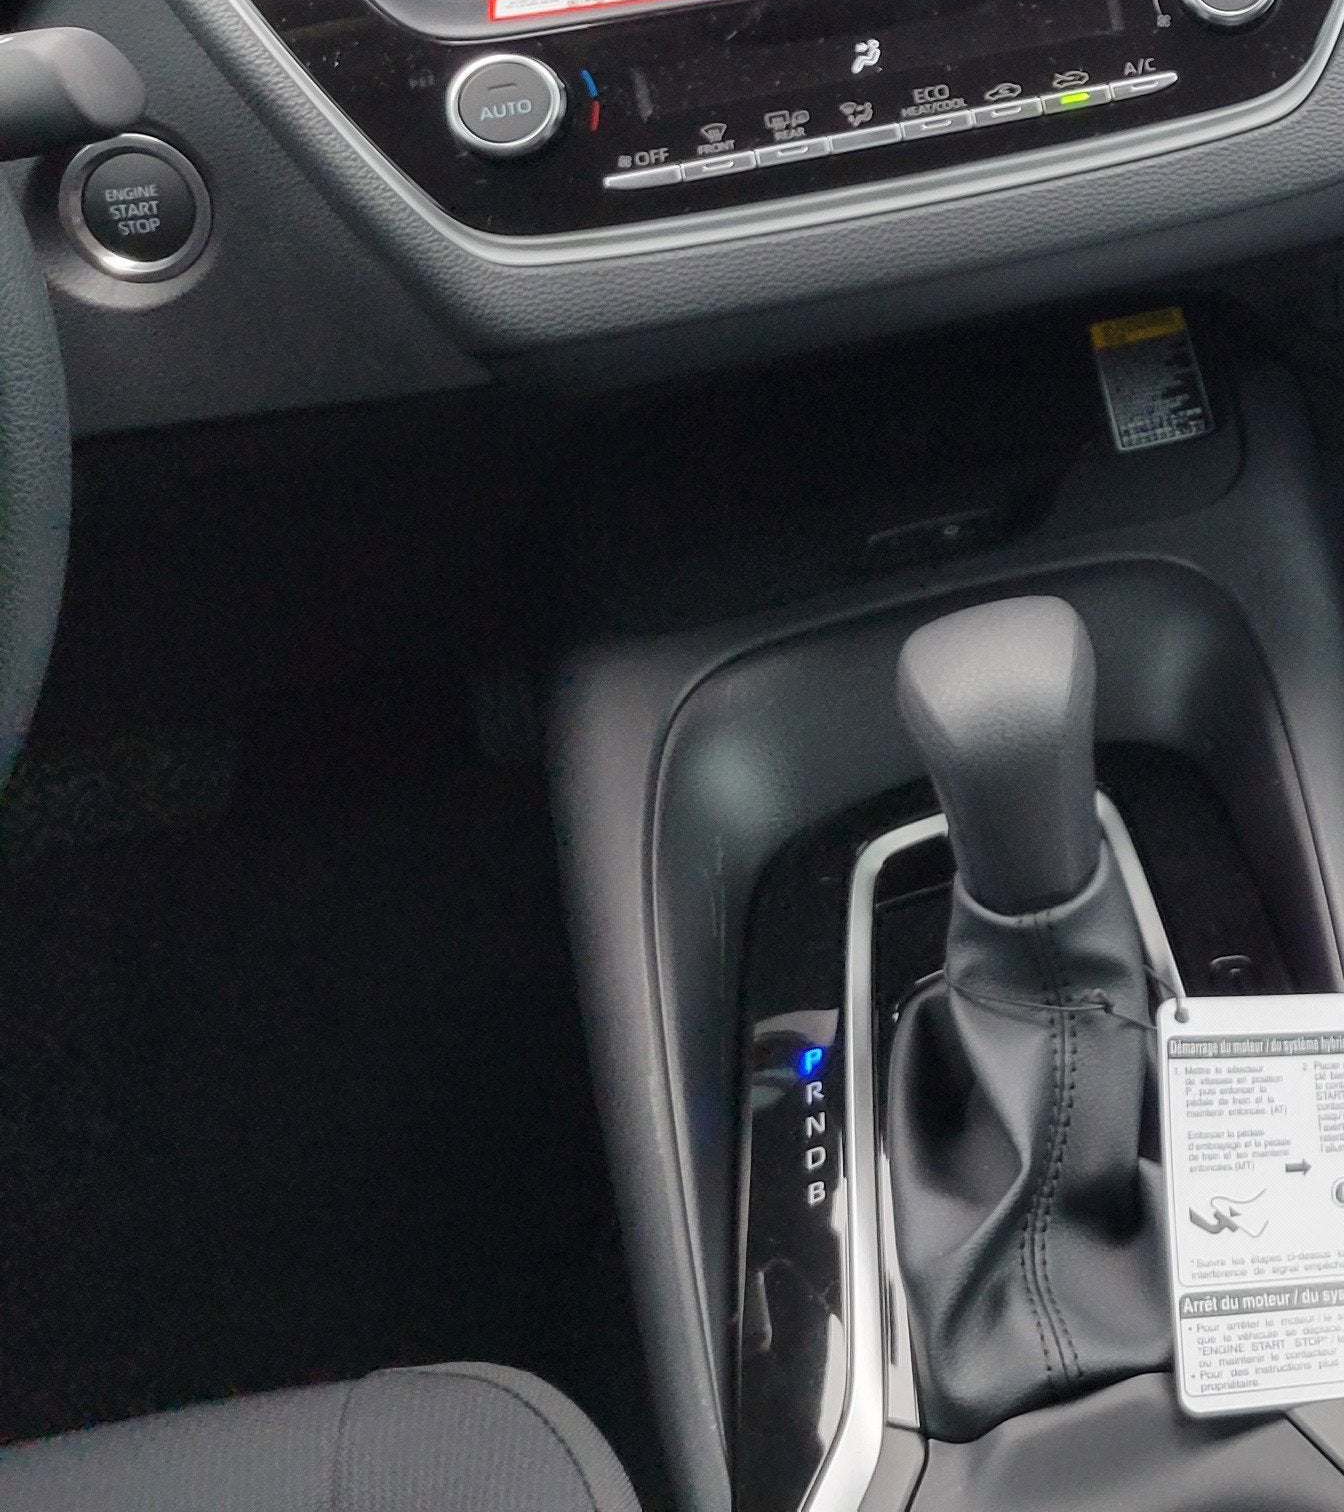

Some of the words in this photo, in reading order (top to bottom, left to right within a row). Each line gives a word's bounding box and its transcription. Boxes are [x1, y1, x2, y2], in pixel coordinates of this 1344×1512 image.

[1124, 57, 1157, 76] A/C
[914, 84, 949, 104] ECO
[481, 99, 532, 121] AUTO
[901, 97, 967, 118] HEAT/COOL
[774, 126, 808, 141] REAR
[697, 139, 736, 155] FRONT
[635, 147, 670, 167] OFF
[105, 184, 157, 202] ENGINE
[109, 200, 160, 219] START
[117, 218, 161, 236] STOP
[1171, 1040, 1218, 1056] Démarrage
[1220, 1040, 1231, 1052] du
[1233, 1039, 1264, 1052] moteur
[1271, 1038, 1281, 1051] du
[1284, 1037, 1319, 1053] système
[804, 1048, 824, 1072] P
[805, 1081, 824, 1103] R
[805, 1112, 826, 1137] N
[805, 1146, 827, 1171] D
[807, 1182, 826, 1207] B
[1184, 1296, 1218, 1312] Arrêt
[1221, 1295, 1238, 1310] du
[1243, 1293, 1290, 1309] moteur
[1301, 1288, 1318, 1304] du
[1197, 1324, 1219, 1332] Pour
[1227, 1319, 1260, 1329] arrêter
[1197, 1334, 1216, 1345] que
[1252, 1339, 1285, 1351] START
[1219, 1355, 1265, 1366] maintenir
[1200, 1370, 1222, 1379] Pour
[1231, 1368, 1249, 1376] des
[1255, 1362, 1312, 1374] instructions
